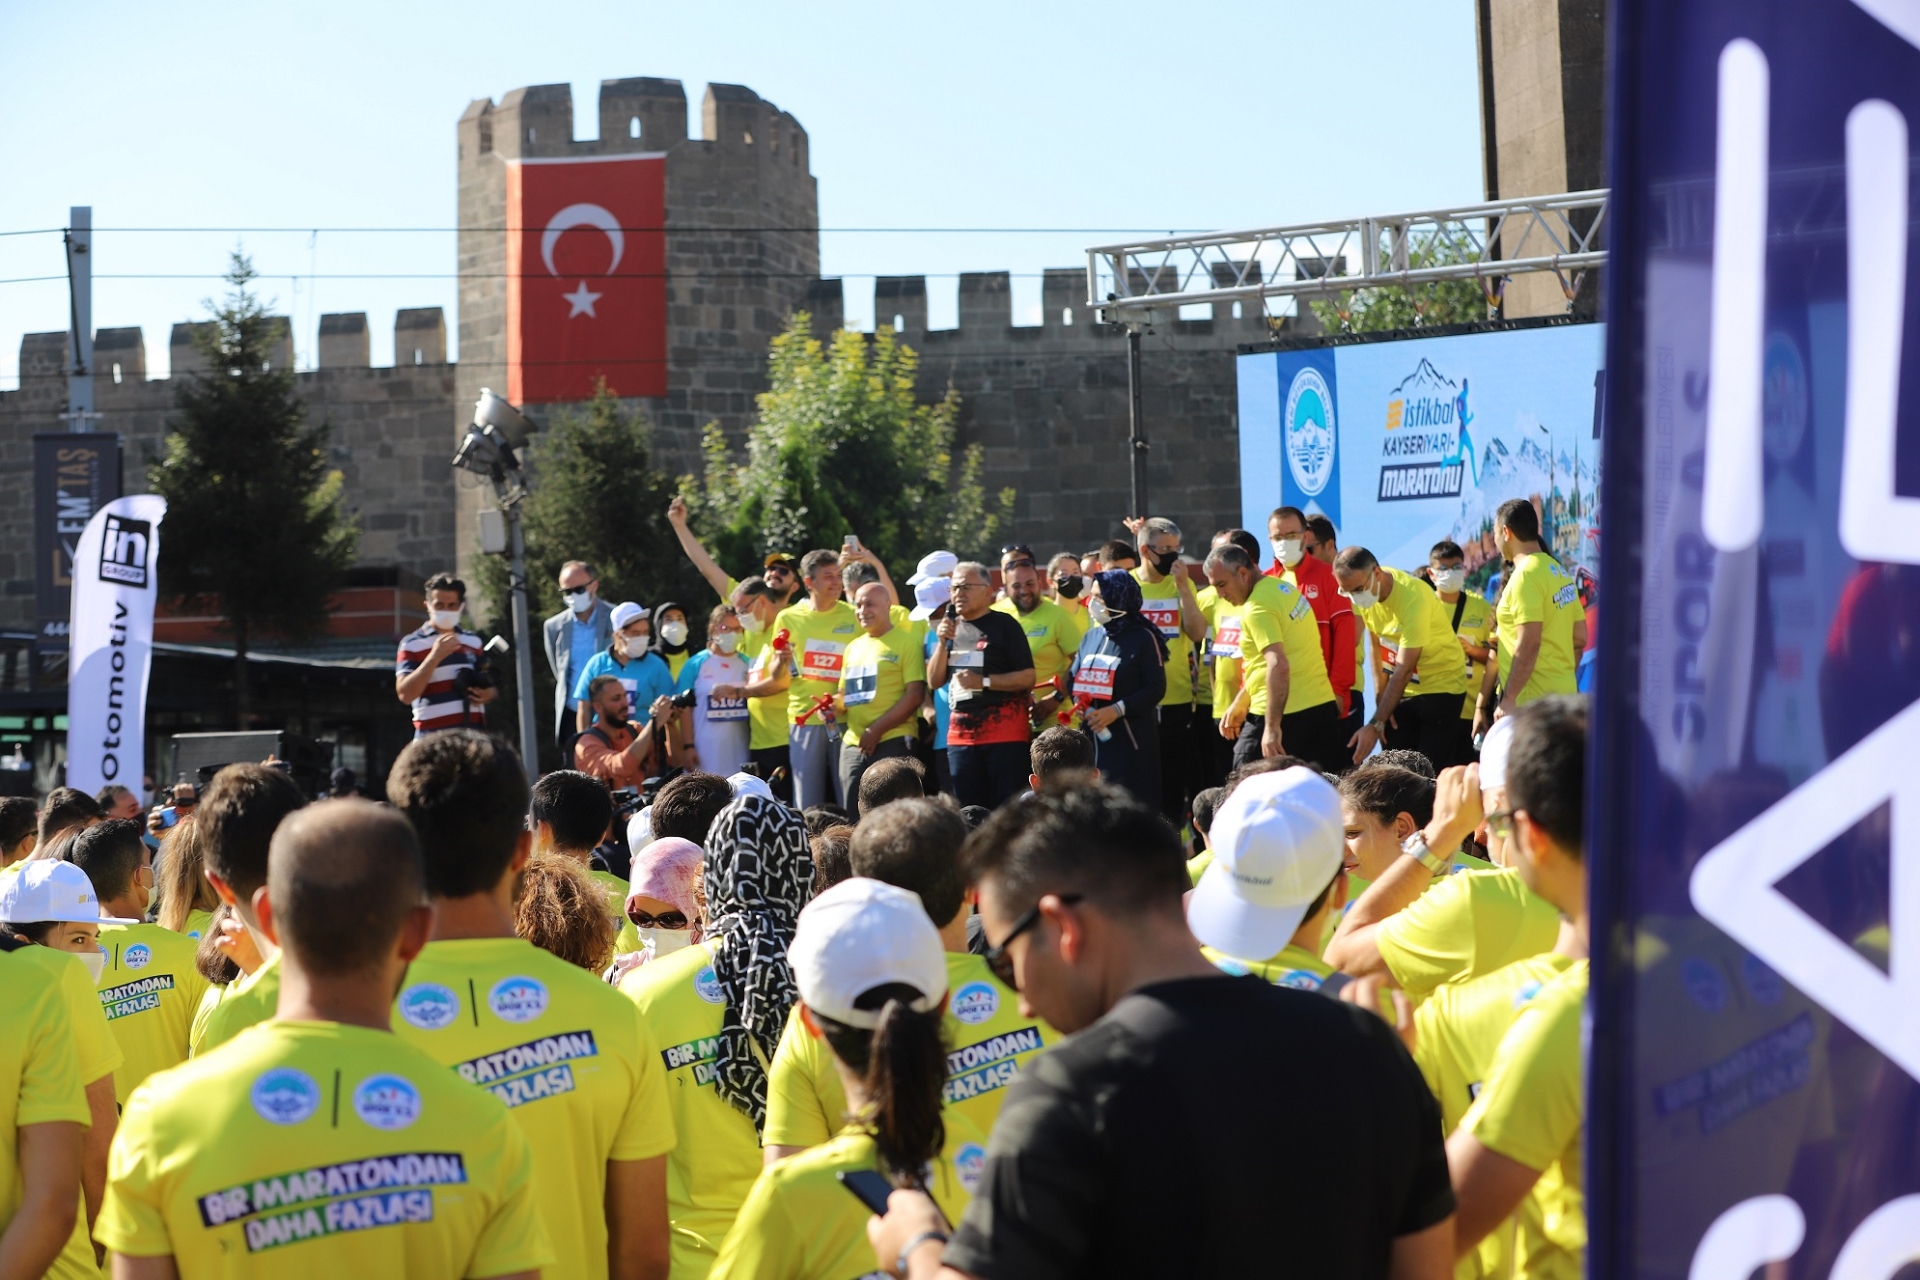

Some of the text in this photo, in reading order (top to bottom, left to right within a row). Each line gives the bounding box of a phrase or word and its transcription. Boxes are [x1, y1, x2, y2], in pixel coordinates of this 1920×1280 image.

[1404, 396, 1456, 428] istikbal
[1381, 465, 1462, 498] MARATONU
[103, 564, 144, 580] GROUP
[813, 654, 837, 668] 127
[101, 601, 128, 781] Otomotiv
[856, 678, 863, 691] 1
[115, 994, 160, 1017] FAZLASI
[486, 1066, 574, 1108] AZLASI
[252, 1154, 462, 1211] MARATONDAN
[246, 1192, 432, 1252] DAHA FAZLASI
